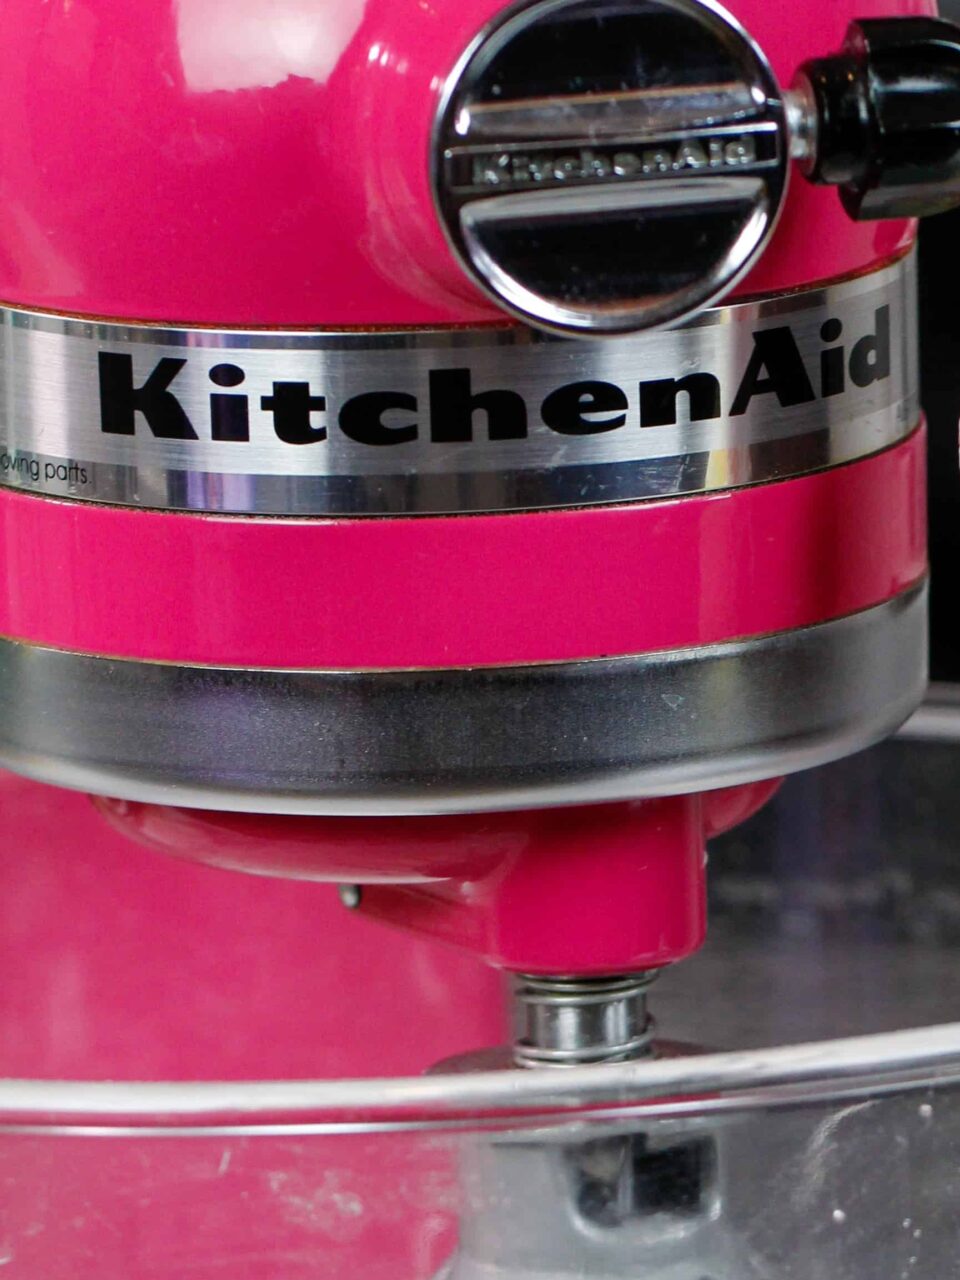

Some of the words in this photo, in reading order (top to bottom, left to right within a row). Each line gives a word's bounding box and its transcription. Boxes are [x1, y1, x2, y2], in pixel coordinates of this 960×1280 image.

[471, 133, 756, 186] KitchenAid
[98, 304, 892, 446] KitchenAid
[45, 461, 92, 485] parts.
